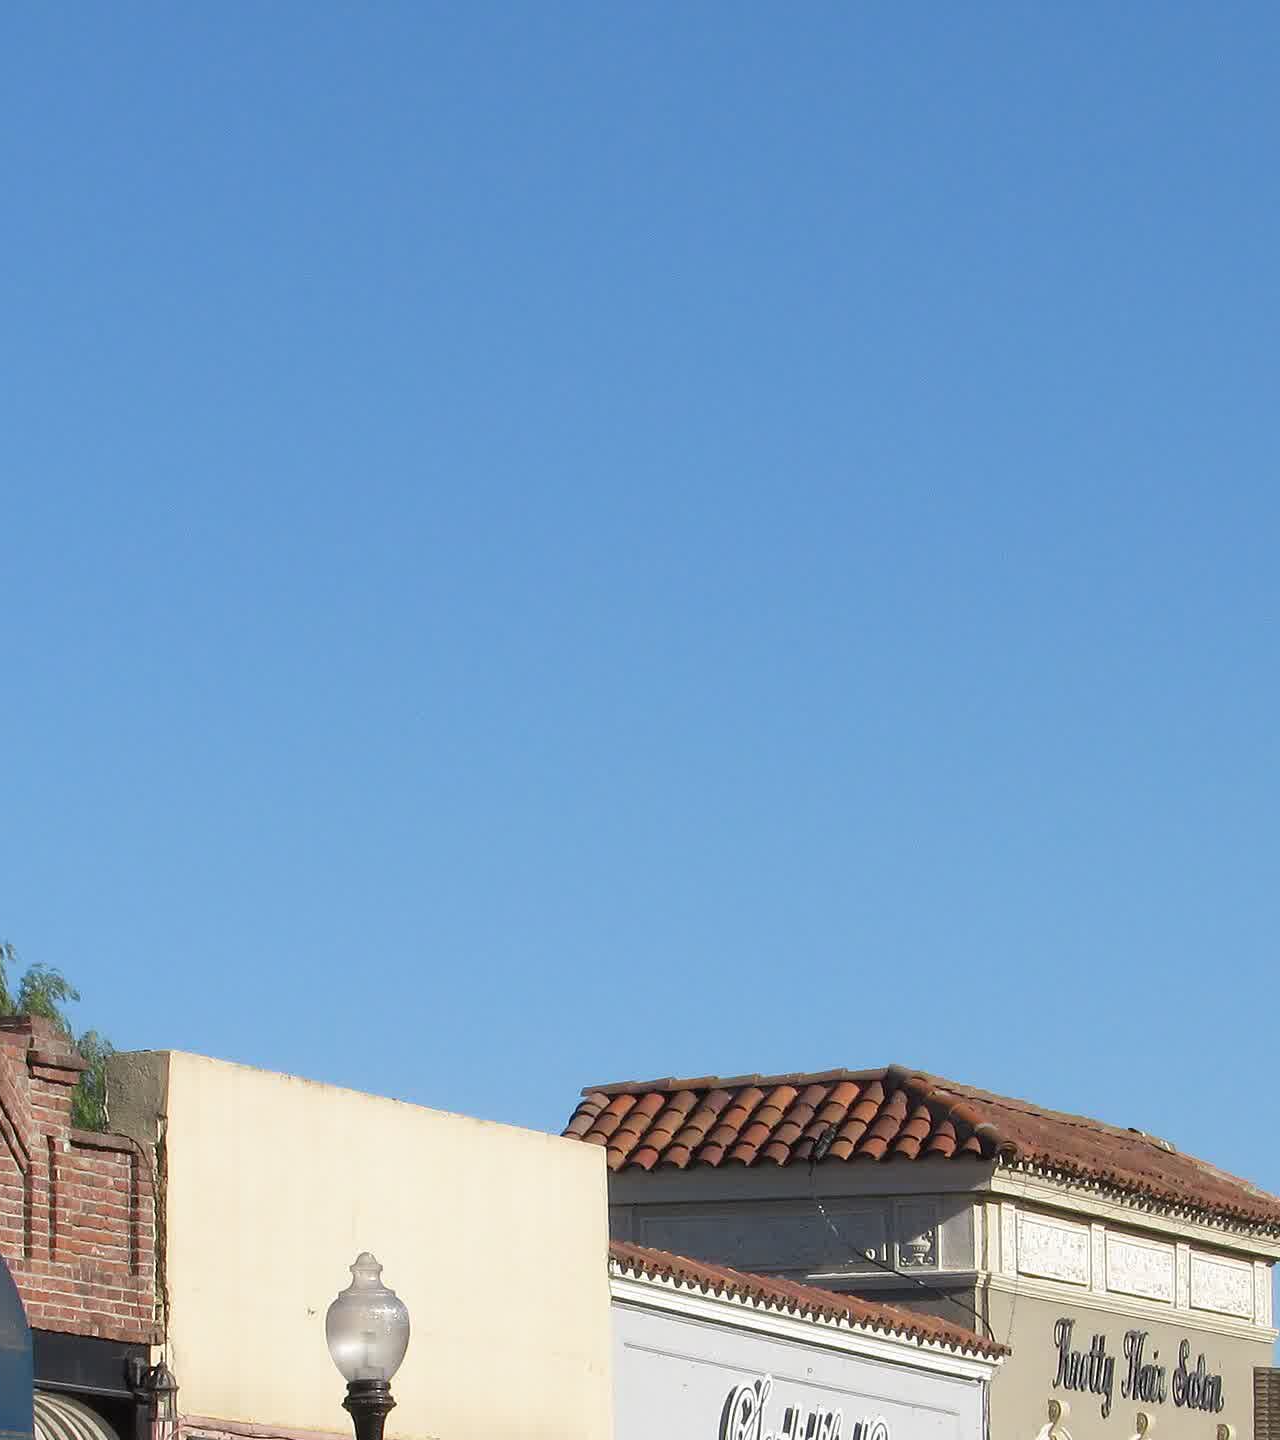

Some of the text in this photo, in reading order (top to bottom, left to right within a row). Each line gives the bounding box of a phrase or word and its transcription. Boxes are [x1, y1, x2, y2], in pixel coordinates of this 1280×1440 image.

[1052, 1317, 1224, 1419] Knotty Hair Salon
